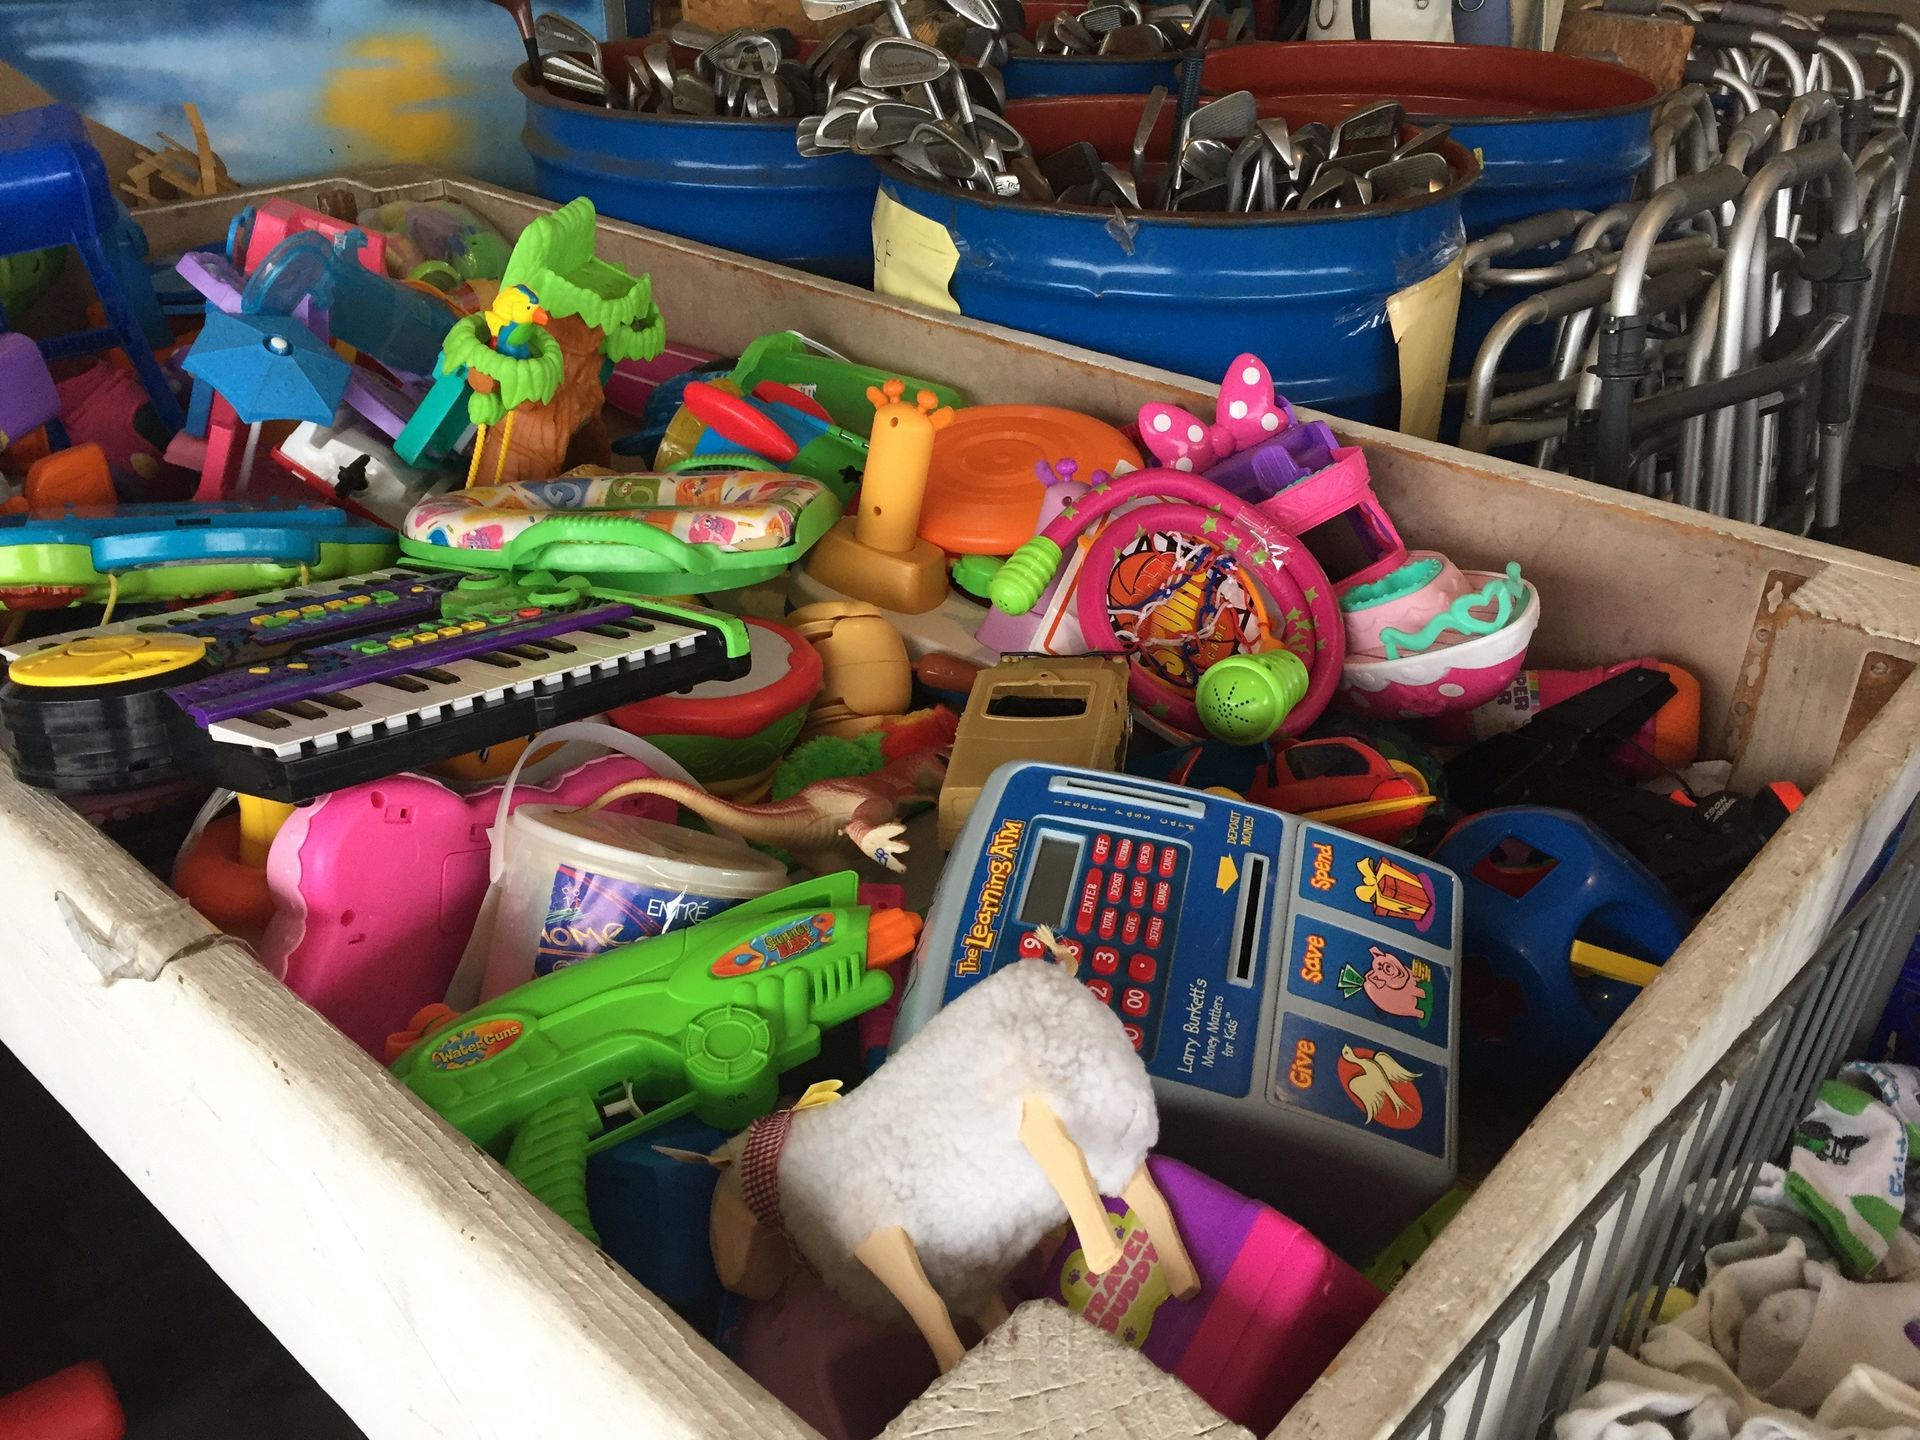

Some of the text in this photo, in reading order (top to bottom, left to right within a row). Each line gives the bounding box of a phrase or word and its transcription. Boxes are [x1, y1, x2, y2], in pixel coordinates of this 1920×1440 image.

[1053, 800, 1195, 831] Insert Pass Card
[1226, 809, 1241, 845] DEPOSIT
[1240, 815, 1255, 847] MONEY
[1096, 837, 1109, 855] OFF
[1139, 845, 1151, 865] SPEND
[1162, 848, 1175, 870] CANCEL
[1310, 842, 1337, 891] Spend
[955, 819, 1026, 978] The Learning ATM
[1081, 883, 1098, 914] ENTER
[1110, 872, 1124, 897] DEPOSIT
[1133, 881, 1144, 897] SAVE
[1102, 911, 1115, 930] TOTAL
[1126, 916, 1138, 933] GIVE
[1095, 951, 1115, 964] 3
[1300, 934, 1326, 984] Save
[1177, 978, 1208, 1074] Larry Burkett's
[1201, 995, 1224, 1068] Money Matters
[439, 1025, 520, 1063] Water Guns
[1222, 1043, 1235, 1058] for
[1288, 1038, 1317, 1090] Give
